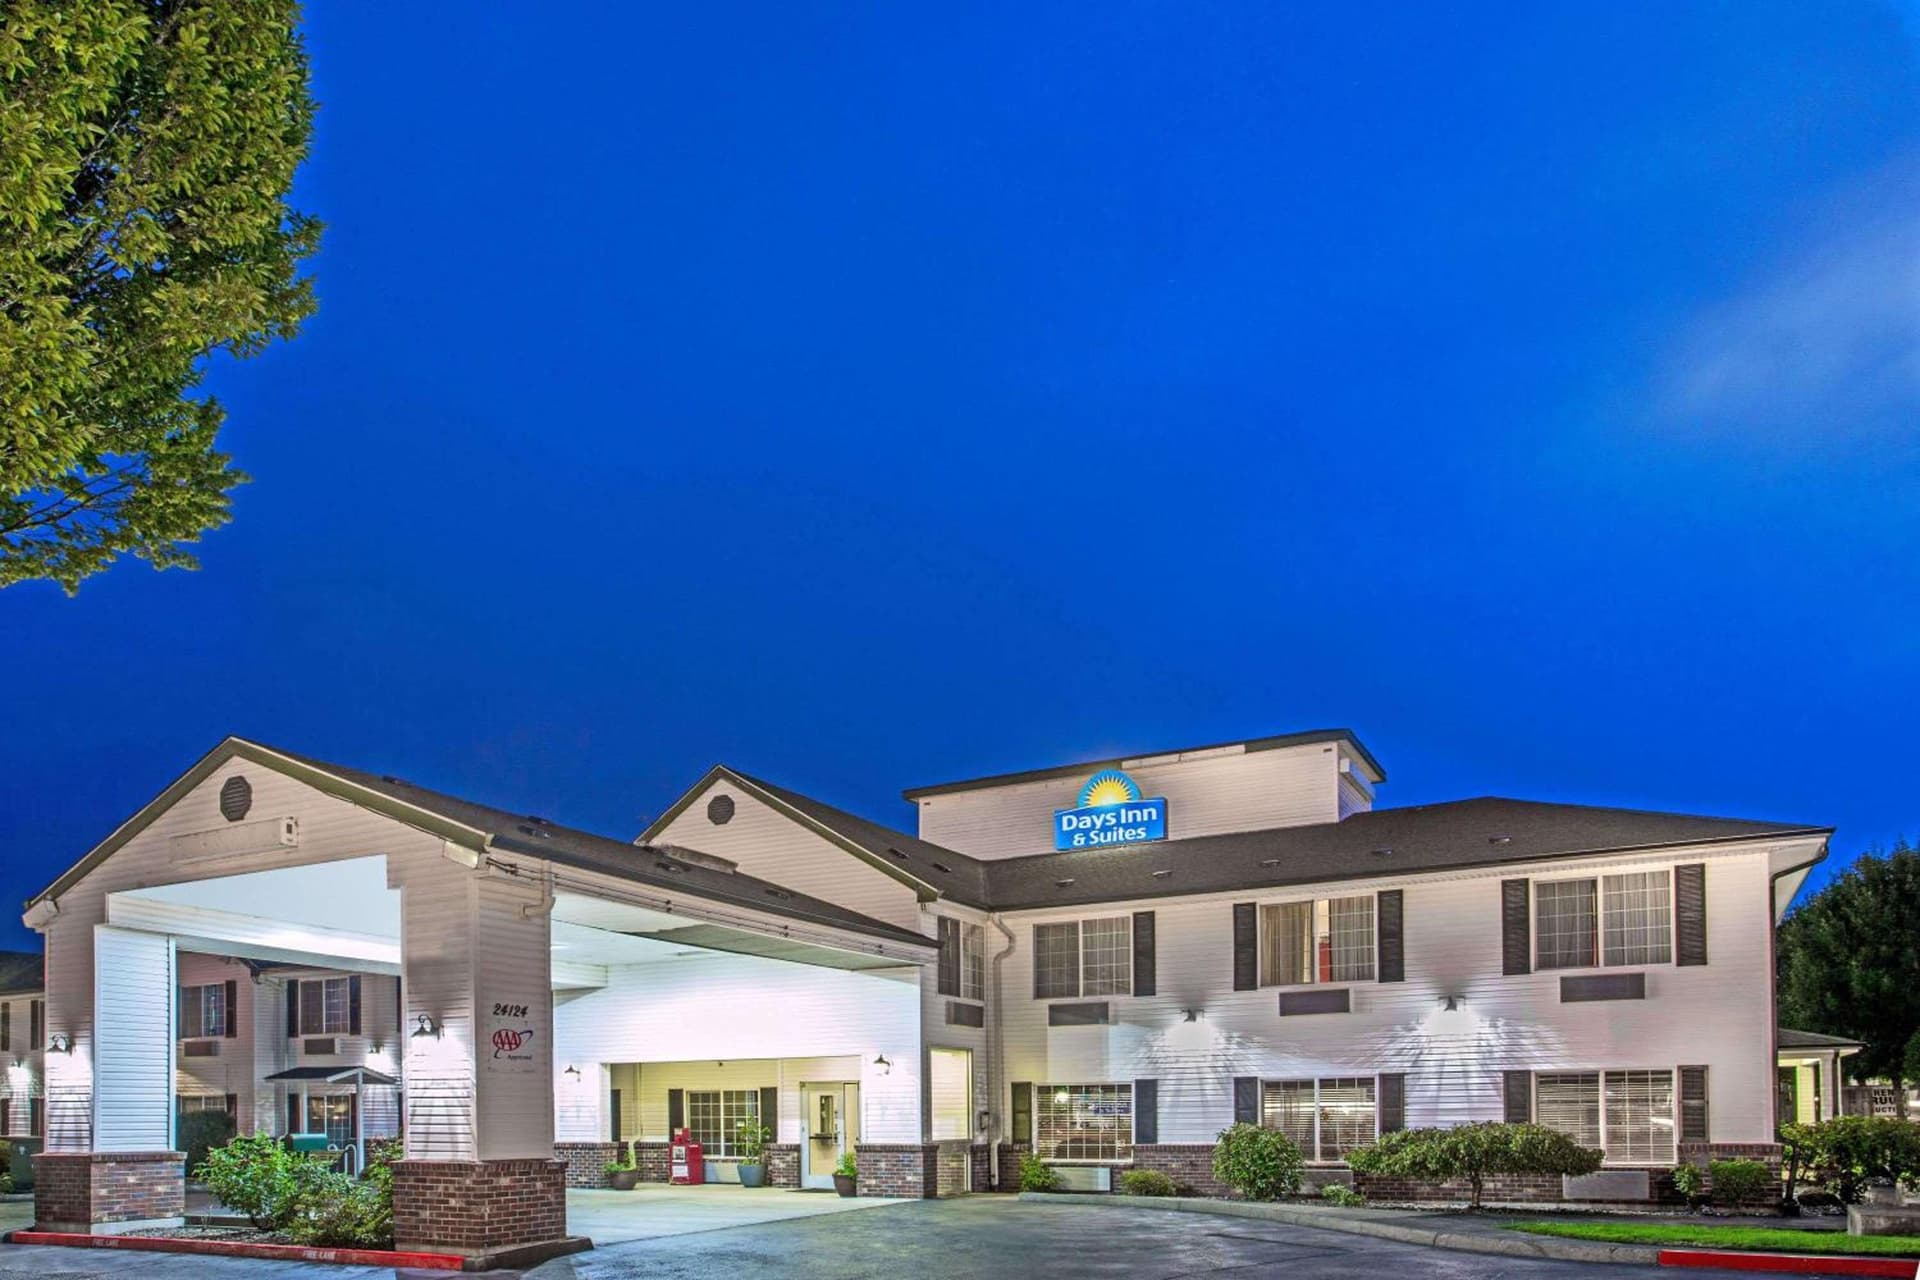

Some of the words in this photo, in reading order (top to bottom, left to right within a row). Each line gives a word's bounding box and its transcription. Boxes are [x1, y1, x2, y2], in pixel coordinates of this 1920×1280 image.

[1062, 812, 1117, 831] Days
[1120, 807, 1157, 824] Inn
[1073, 833, 1086, 846] &
[1089, 826, 1147, 845] Suites
[493, 1002, 529, 1018] 24124
[494, 1029, 520, 1051] AAA
